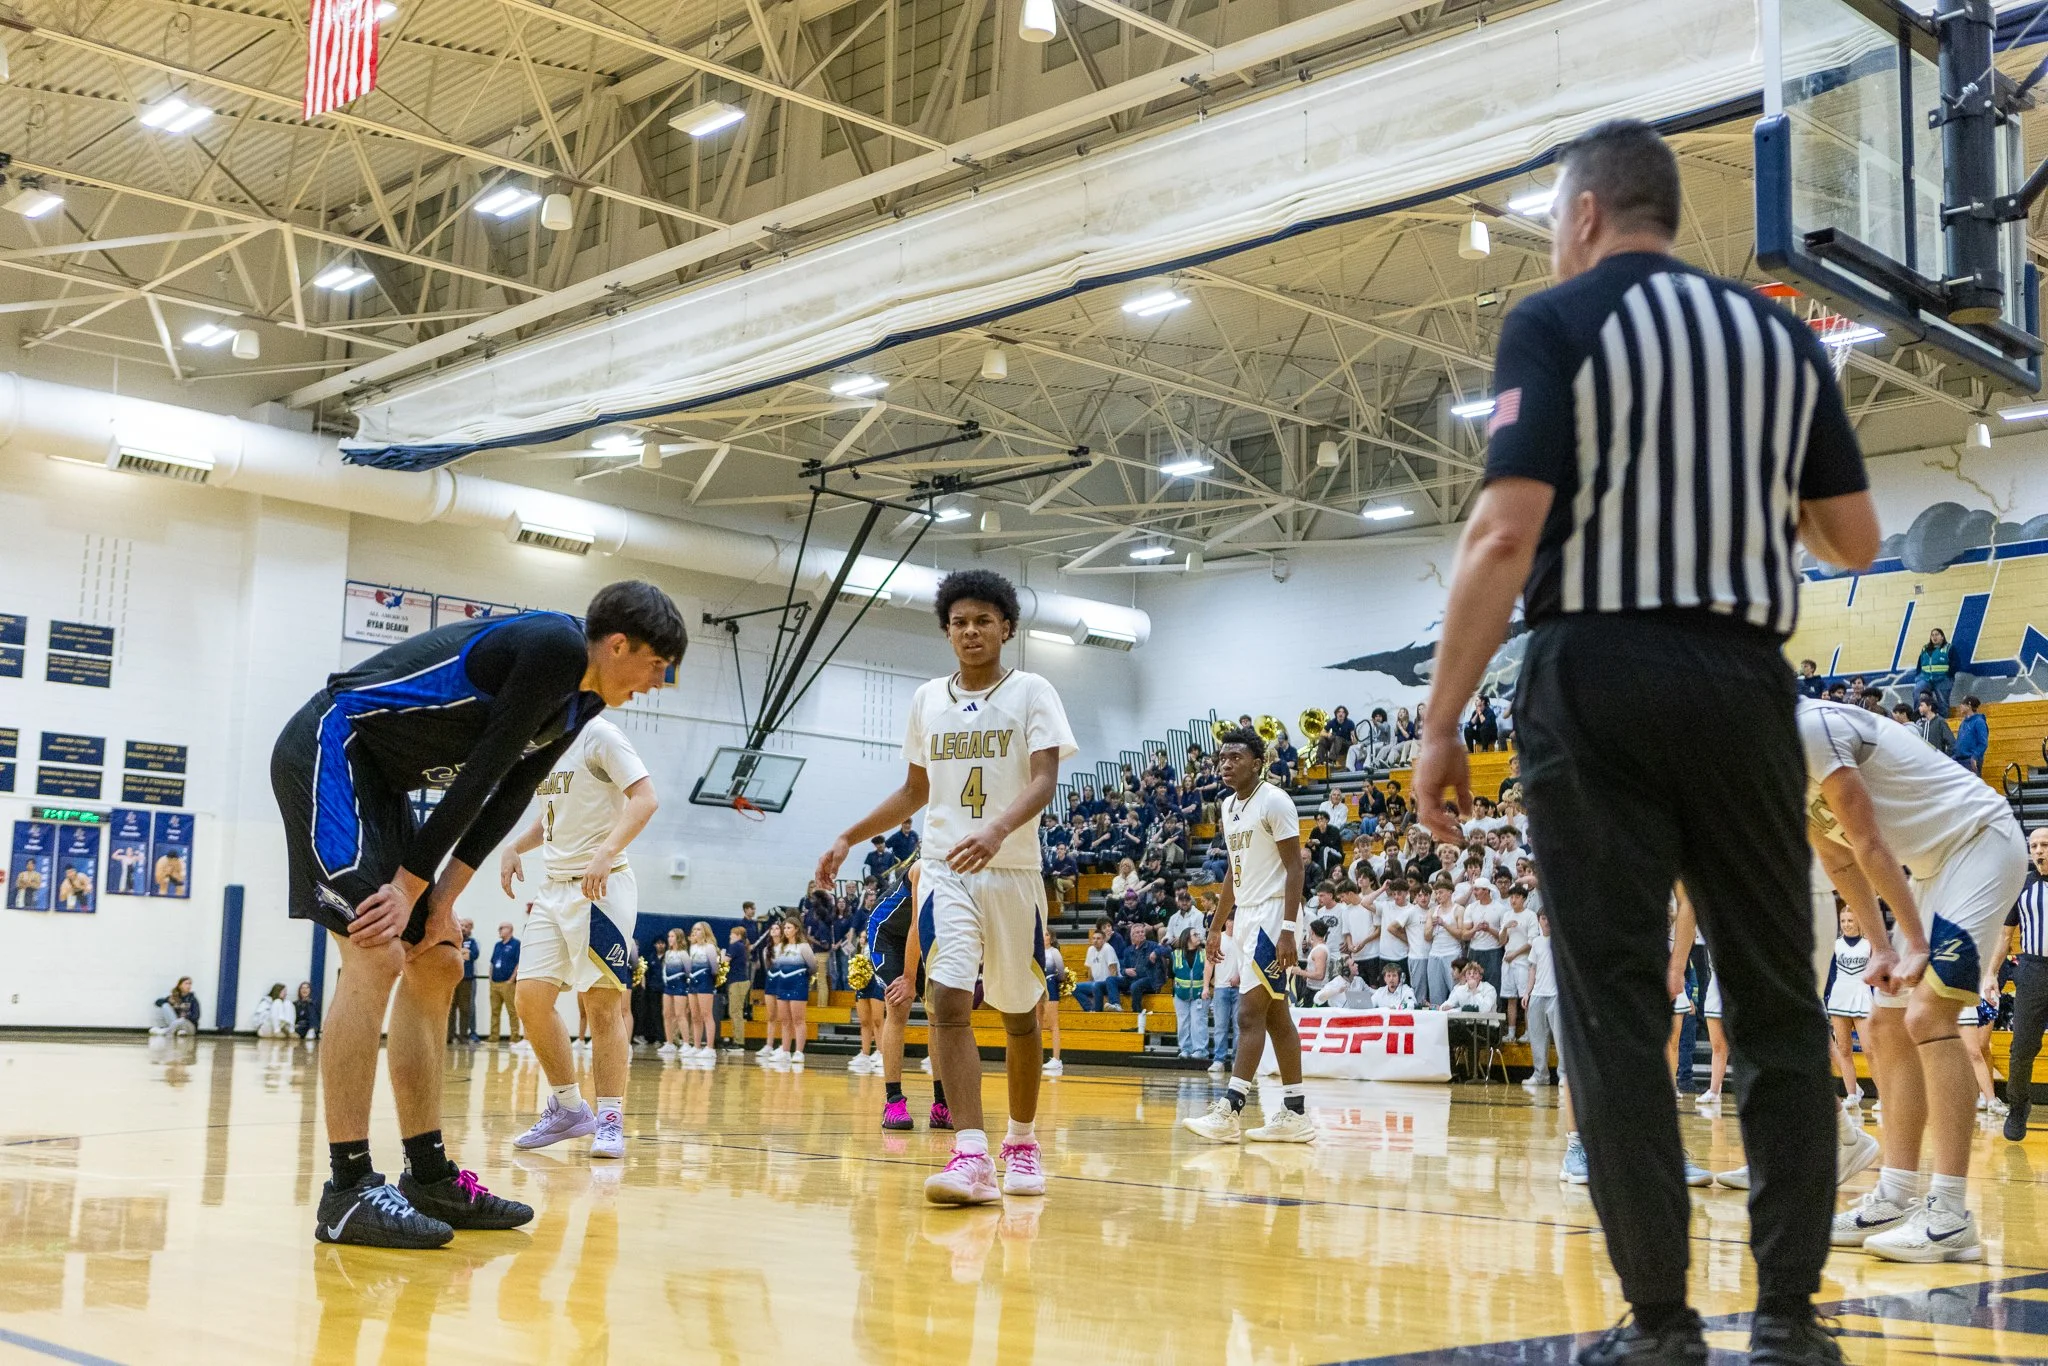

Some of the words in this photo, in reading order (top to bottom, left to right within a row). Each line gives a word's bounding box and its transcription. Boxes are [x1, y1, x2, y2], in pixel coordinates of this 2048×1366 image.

[366, 620, 384, 629] RYAN
[930, 728, 1013, 761] LEGACY
[960, 766, 987, 819] 4
[1837, 953, 1869, 966] Legacy
[1297, 1013, 1415, 1055] ESPN
